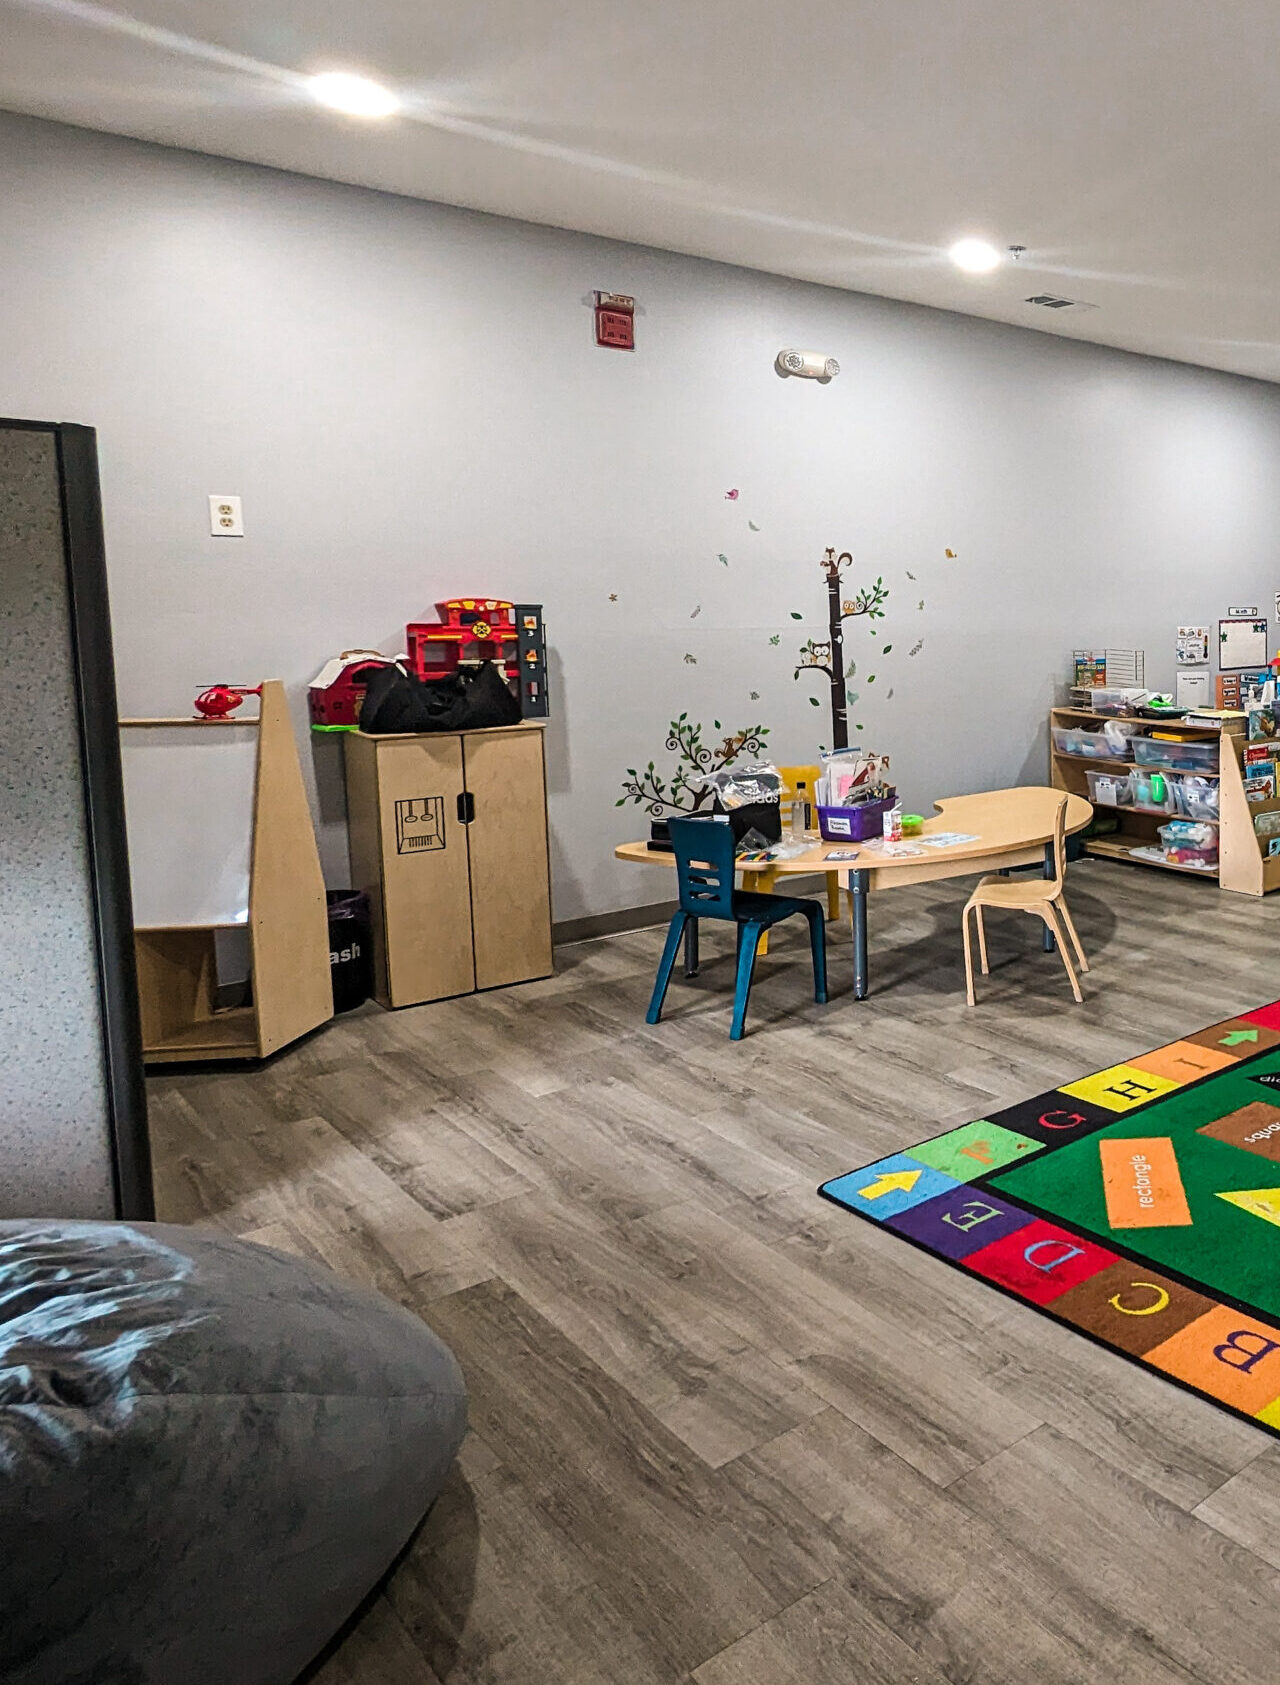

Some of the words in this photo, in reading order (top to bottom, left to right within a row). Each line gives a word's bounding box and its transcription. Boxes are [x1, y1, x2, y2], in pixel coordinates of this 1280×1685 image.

[329, 942, 361, 965] ash
[1103, 1079, 1158, 1101] H
[1038, 1109, 1087, 1130] G
[1129, 1154, 1155, 1209] rectangle
[941, 1201, 1005, 1233] E
[1024, 1239, 1085, 1274] D
[1108, 1282, 1170, 1316] C
